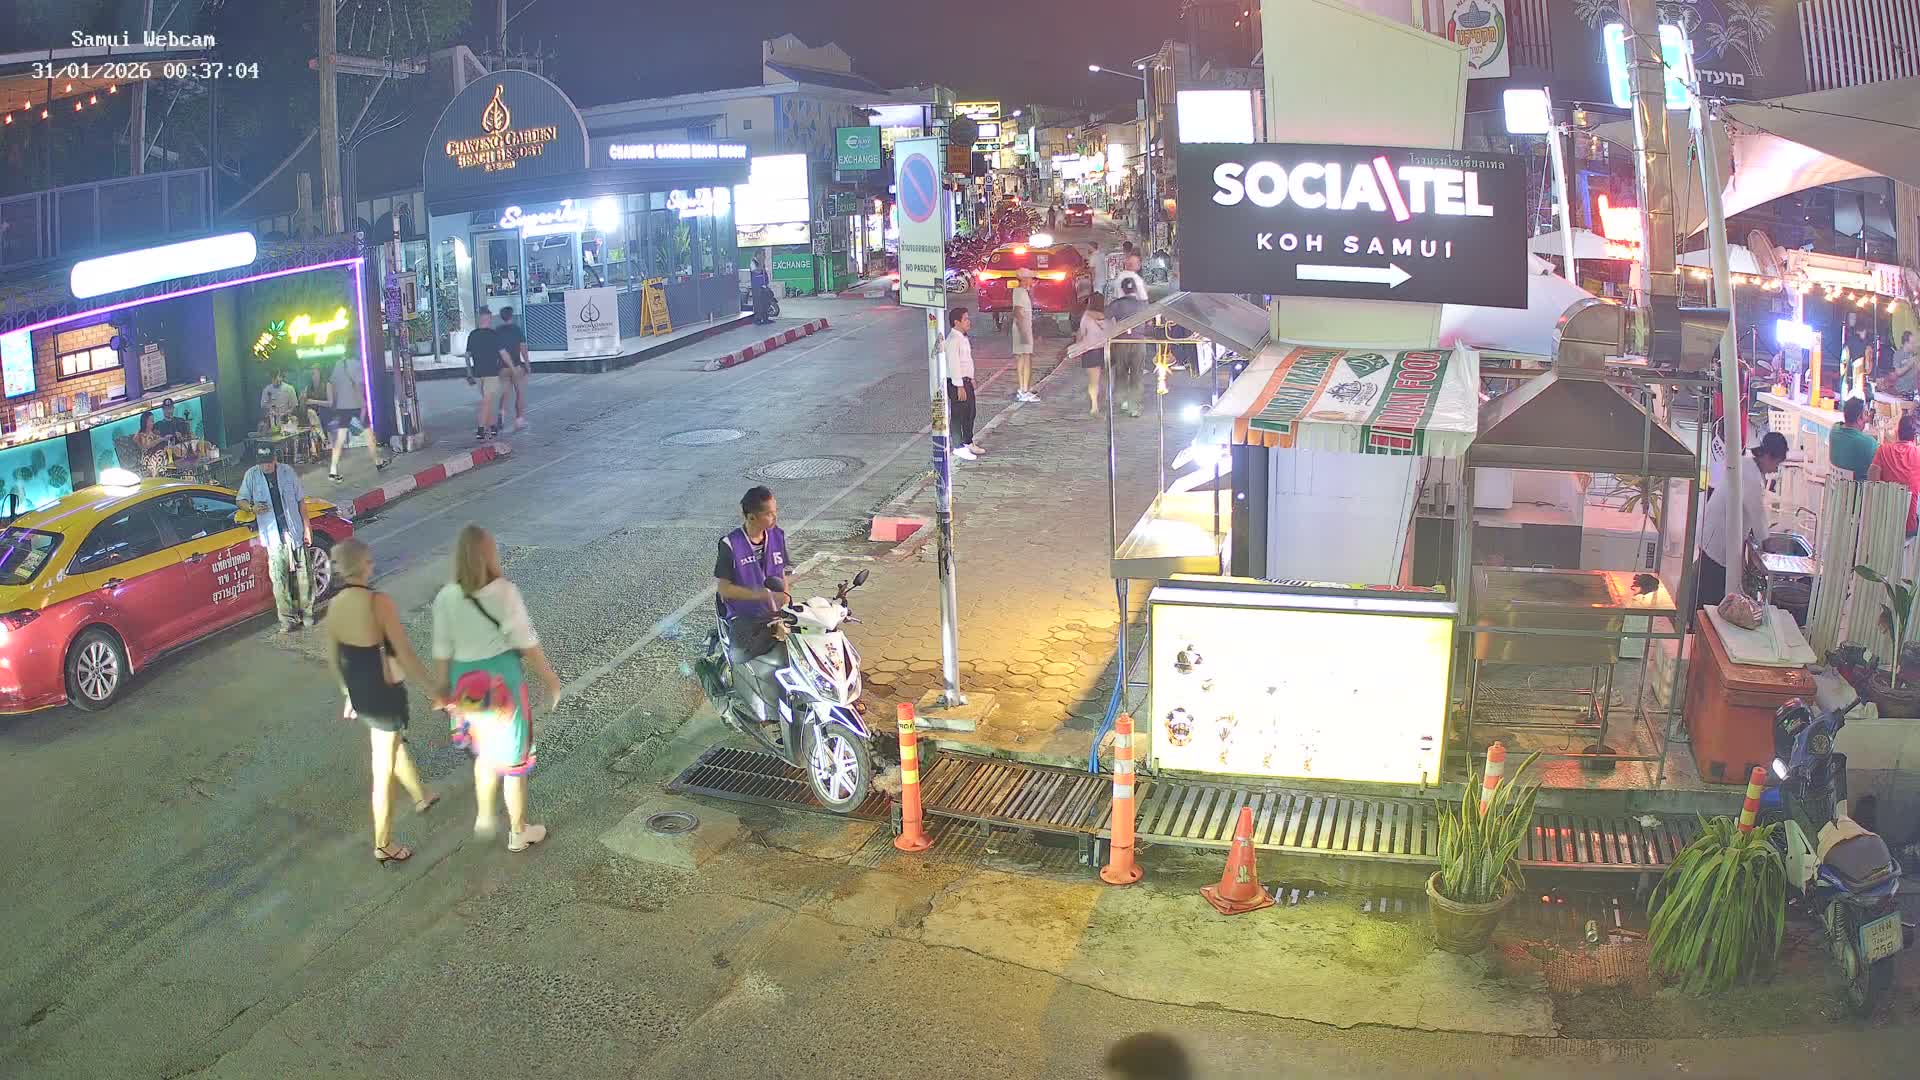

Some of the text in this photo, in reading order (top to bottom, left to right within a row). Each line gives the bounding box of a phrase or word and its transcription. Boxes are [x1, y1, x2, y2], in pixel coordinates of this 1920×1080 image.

[839, 154, 879, 164] EXCHANGE
[1256, 232, 1452, 259] KOH SAMUI
[772, 260, 811, 270] EXCHANGE
[1368, 351, 1442, 451] INDIAN FOOD
